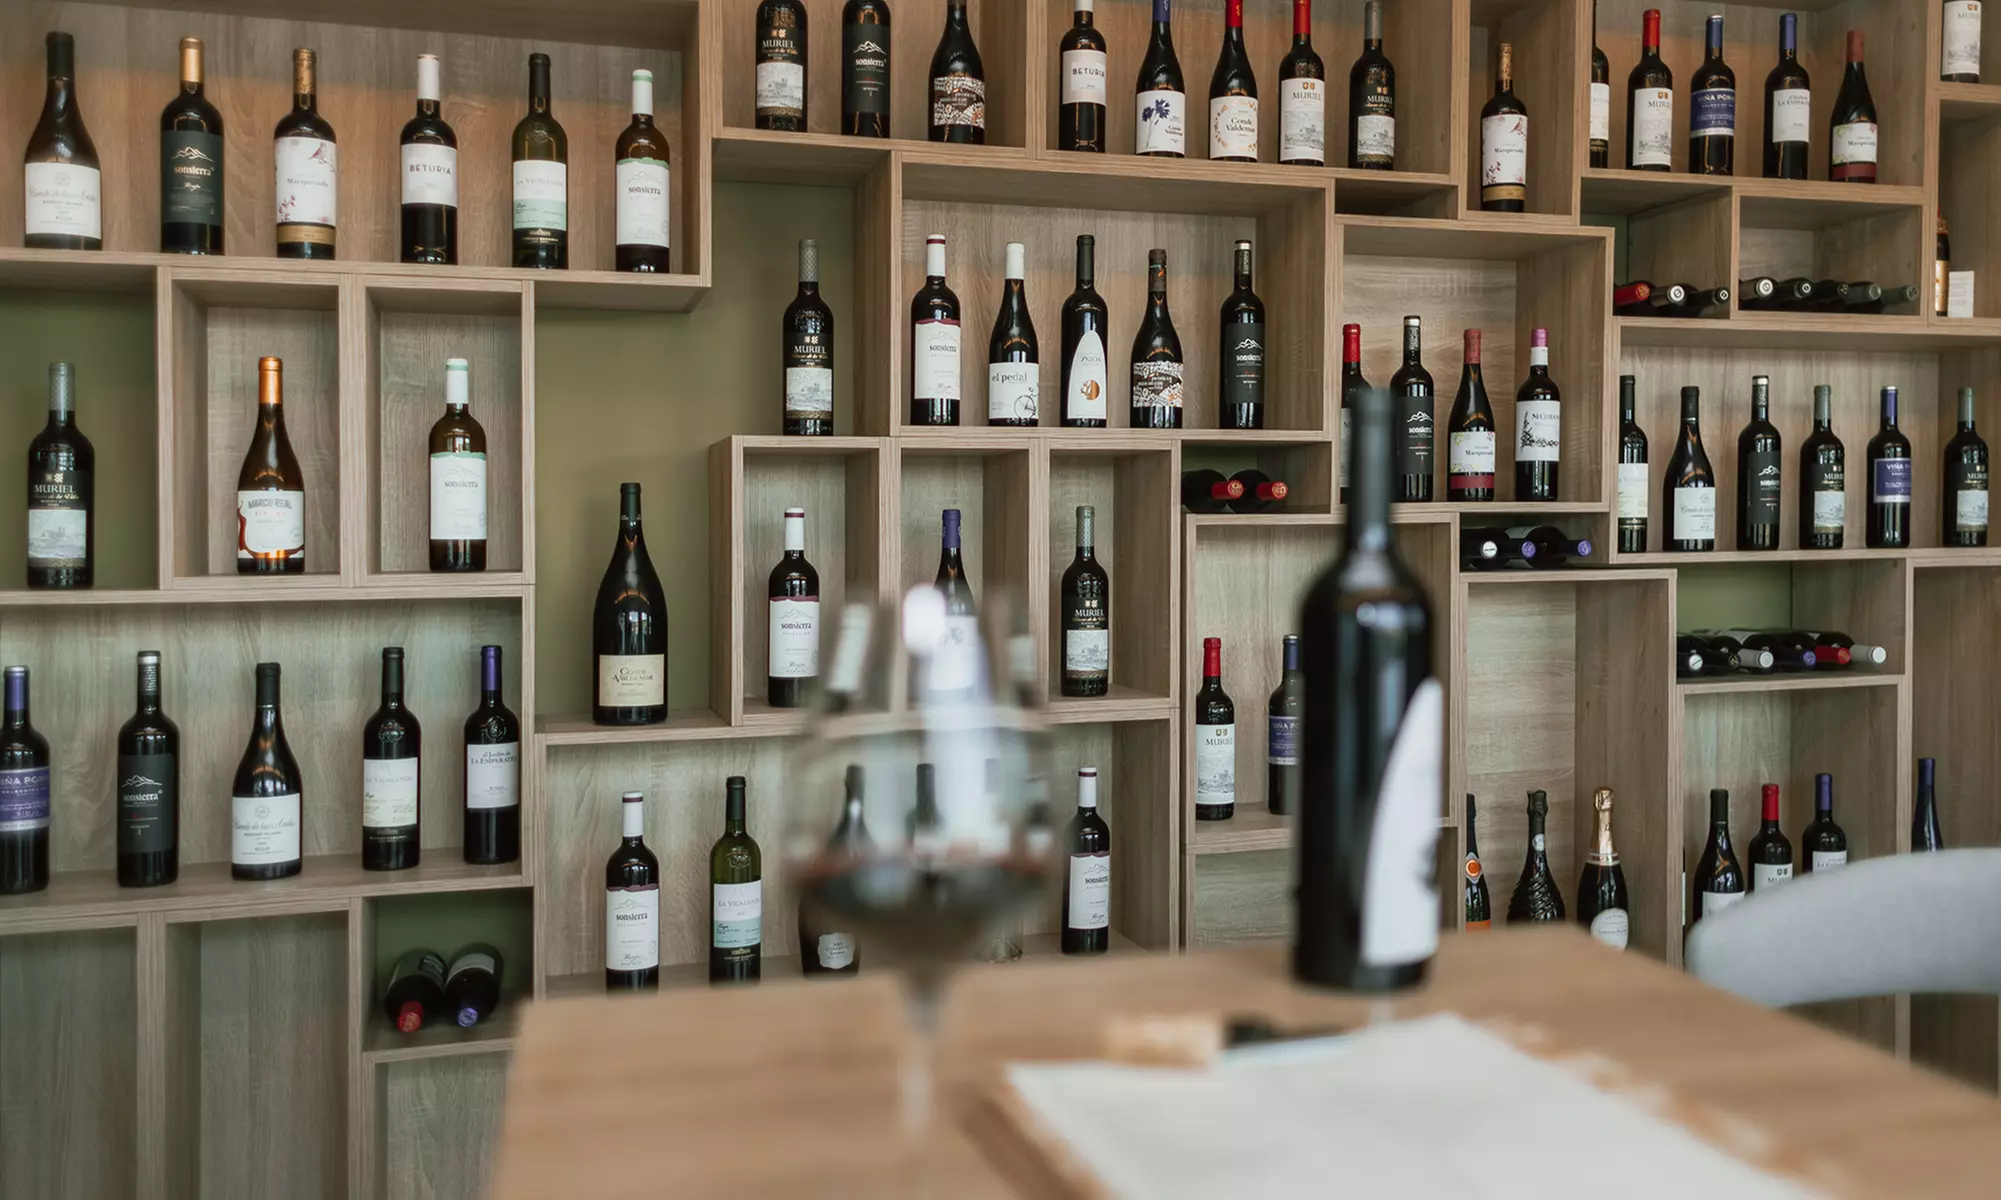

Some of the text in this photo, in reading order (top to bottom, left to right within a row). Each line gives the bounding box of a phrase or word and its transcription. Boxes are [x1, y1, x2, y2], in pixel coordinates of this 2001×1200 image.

[762, 39, 795, 49] MURIEL
[855, 57, 884, 67] sonsierra
[1072, 67, 1105, 78] BETURIA
[1292, 91, 1322, 101] MURIEL
[174, 164, 212, 176] sonsierra
[409, 163, 452, 176] BETURIA
[628, 184, 661, 195] sonsierra
[794, 345, 827, 354] MURIEL
[992, 372, 1028, 383] el pedal
[34, 484, 76, 493] MURIEL
[444, 480, 478, 488] sonsierra
[1074, 608, 1104, 617] MURIEL
[781, 622, 812, 630] sonsierra
[0, 774, 21, 785] IÑA
[123, 793, 159, 802] sonsierra
[615, 912, 648, 921] sonsierra
